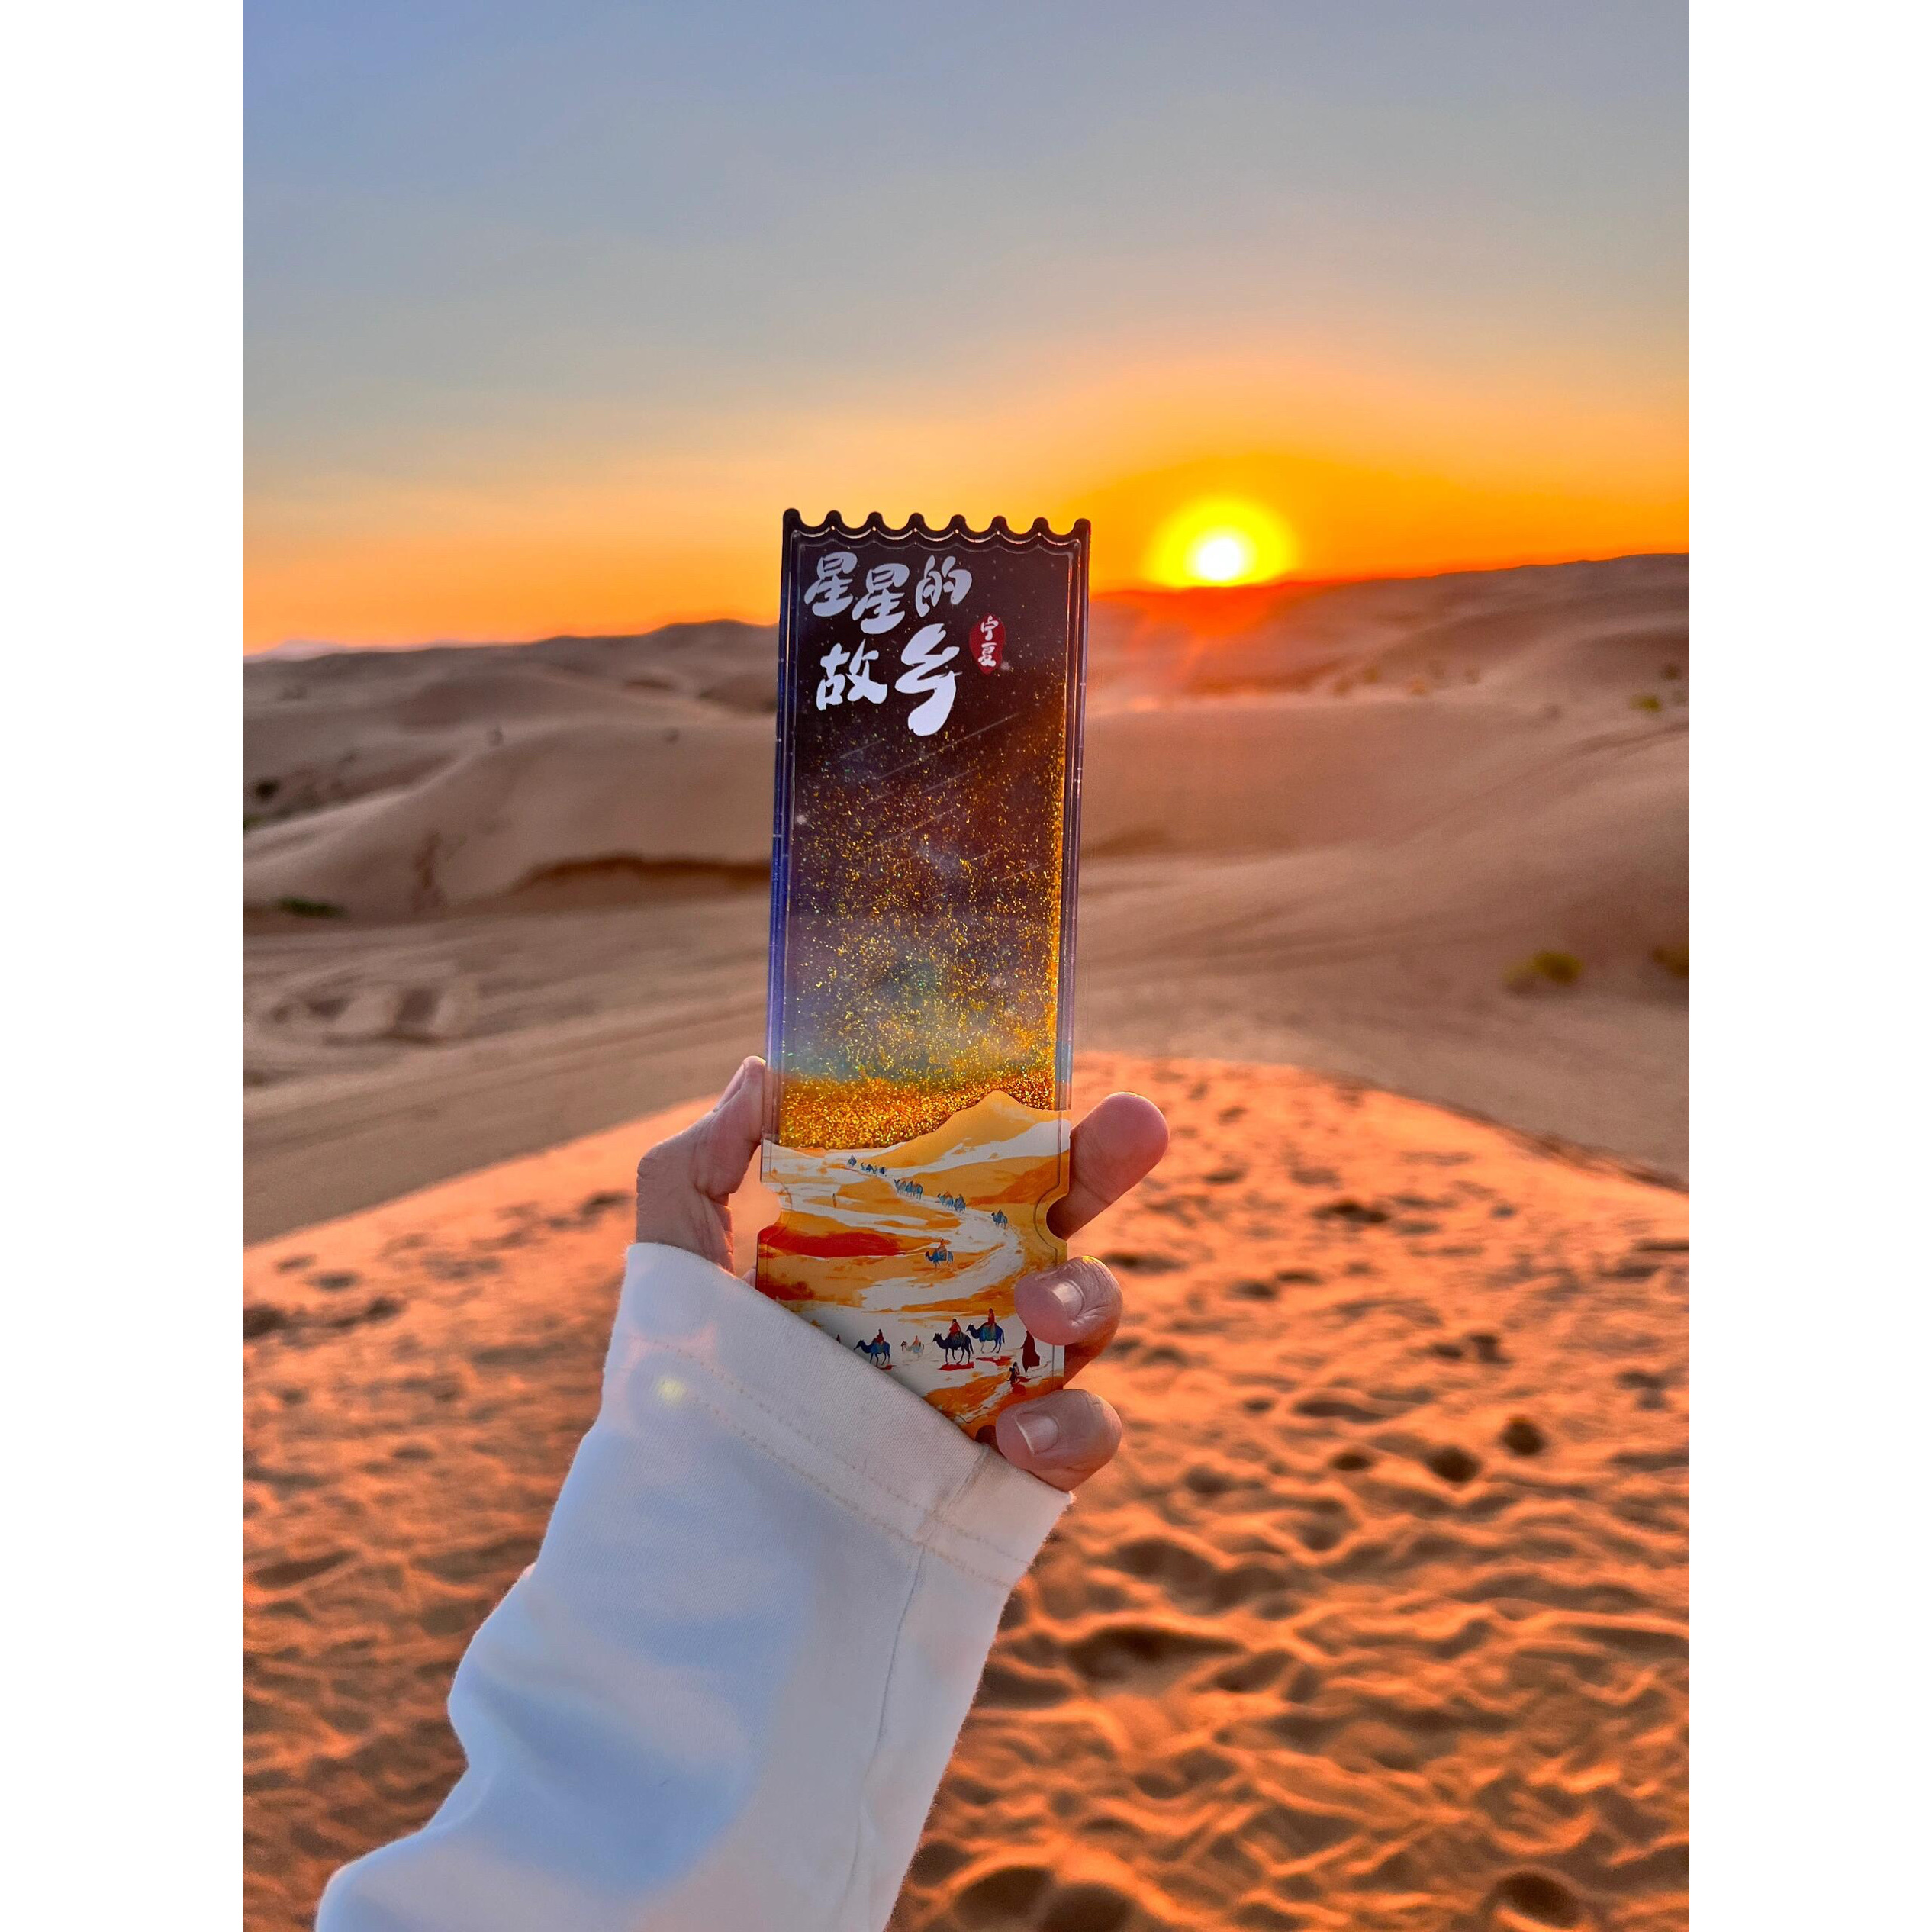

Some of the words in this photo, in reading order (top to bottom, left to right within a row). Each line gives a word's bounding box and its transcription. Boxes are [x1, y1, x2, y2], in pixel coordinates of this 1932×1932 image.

[803, 552, 972, 634] 星星的
[816, 623, 963, 736] 故乡
[977, 616, 999, 668] 宁夏
